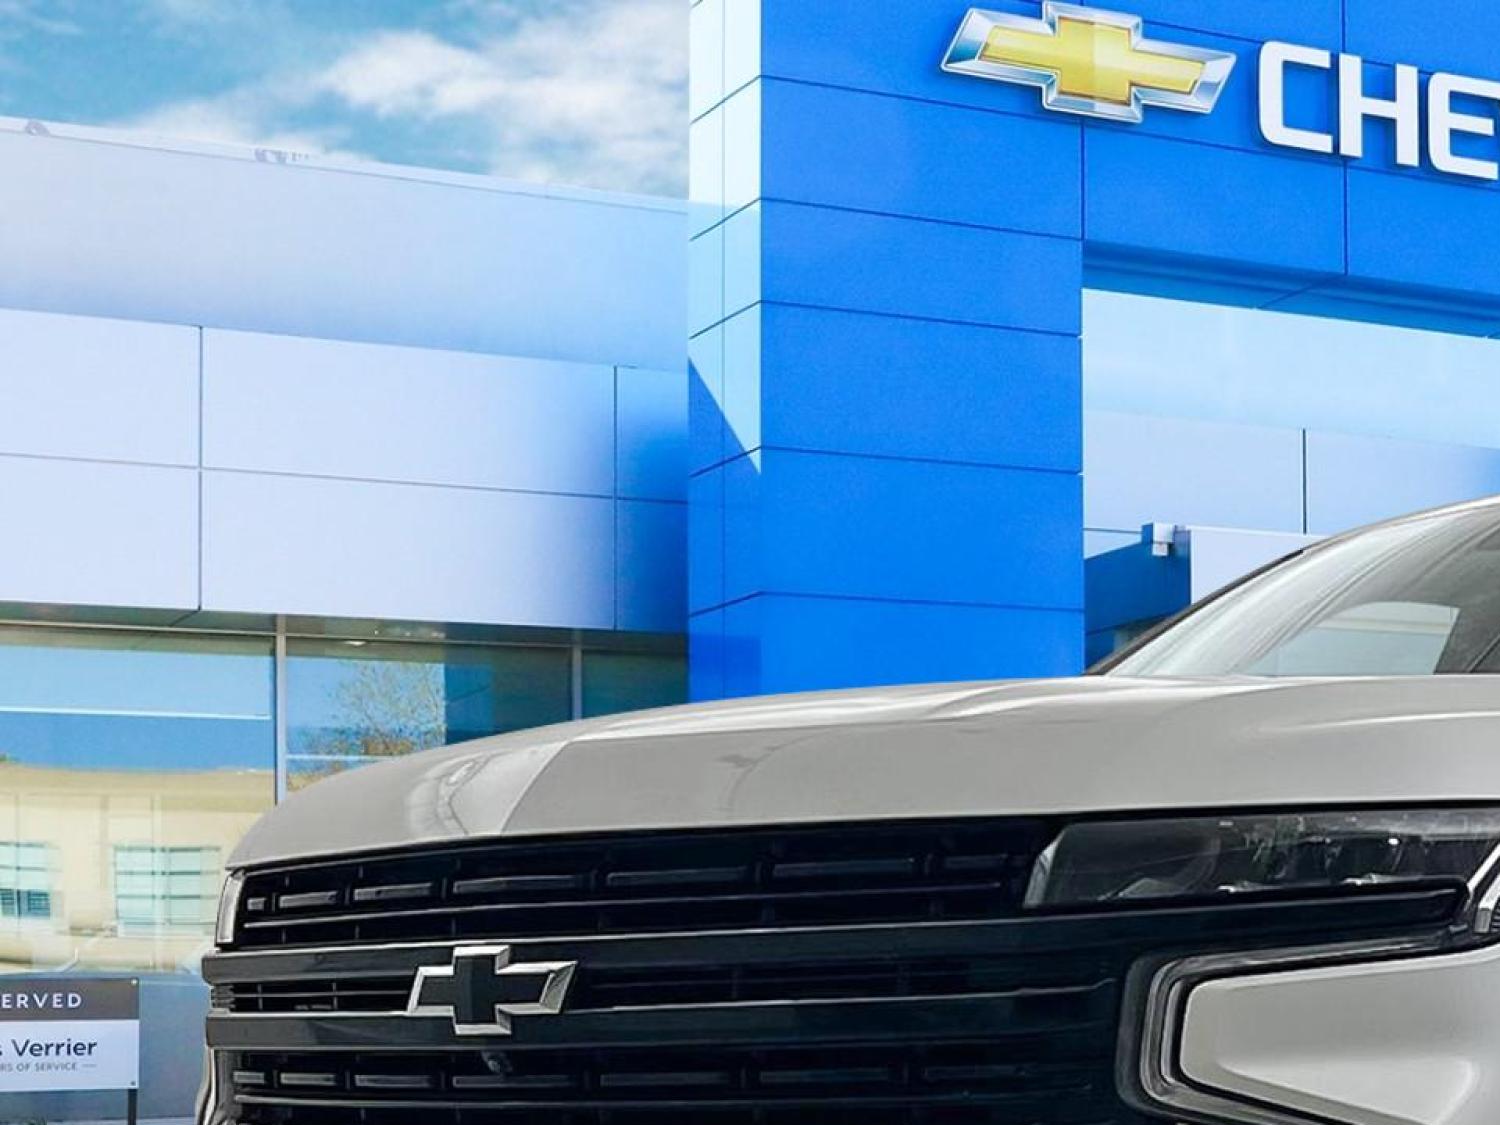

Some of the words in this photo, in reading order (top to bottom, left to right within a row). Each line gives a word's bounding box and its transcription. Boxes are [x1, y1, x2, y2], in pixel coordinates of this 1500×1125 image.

[2, 992, 82, 1009] ERVED
[11, 1038, 97, 1058] Verrier
[16, 1062, 30, 1072] OF
[35, 1062, 77, 1072] SERVICE
